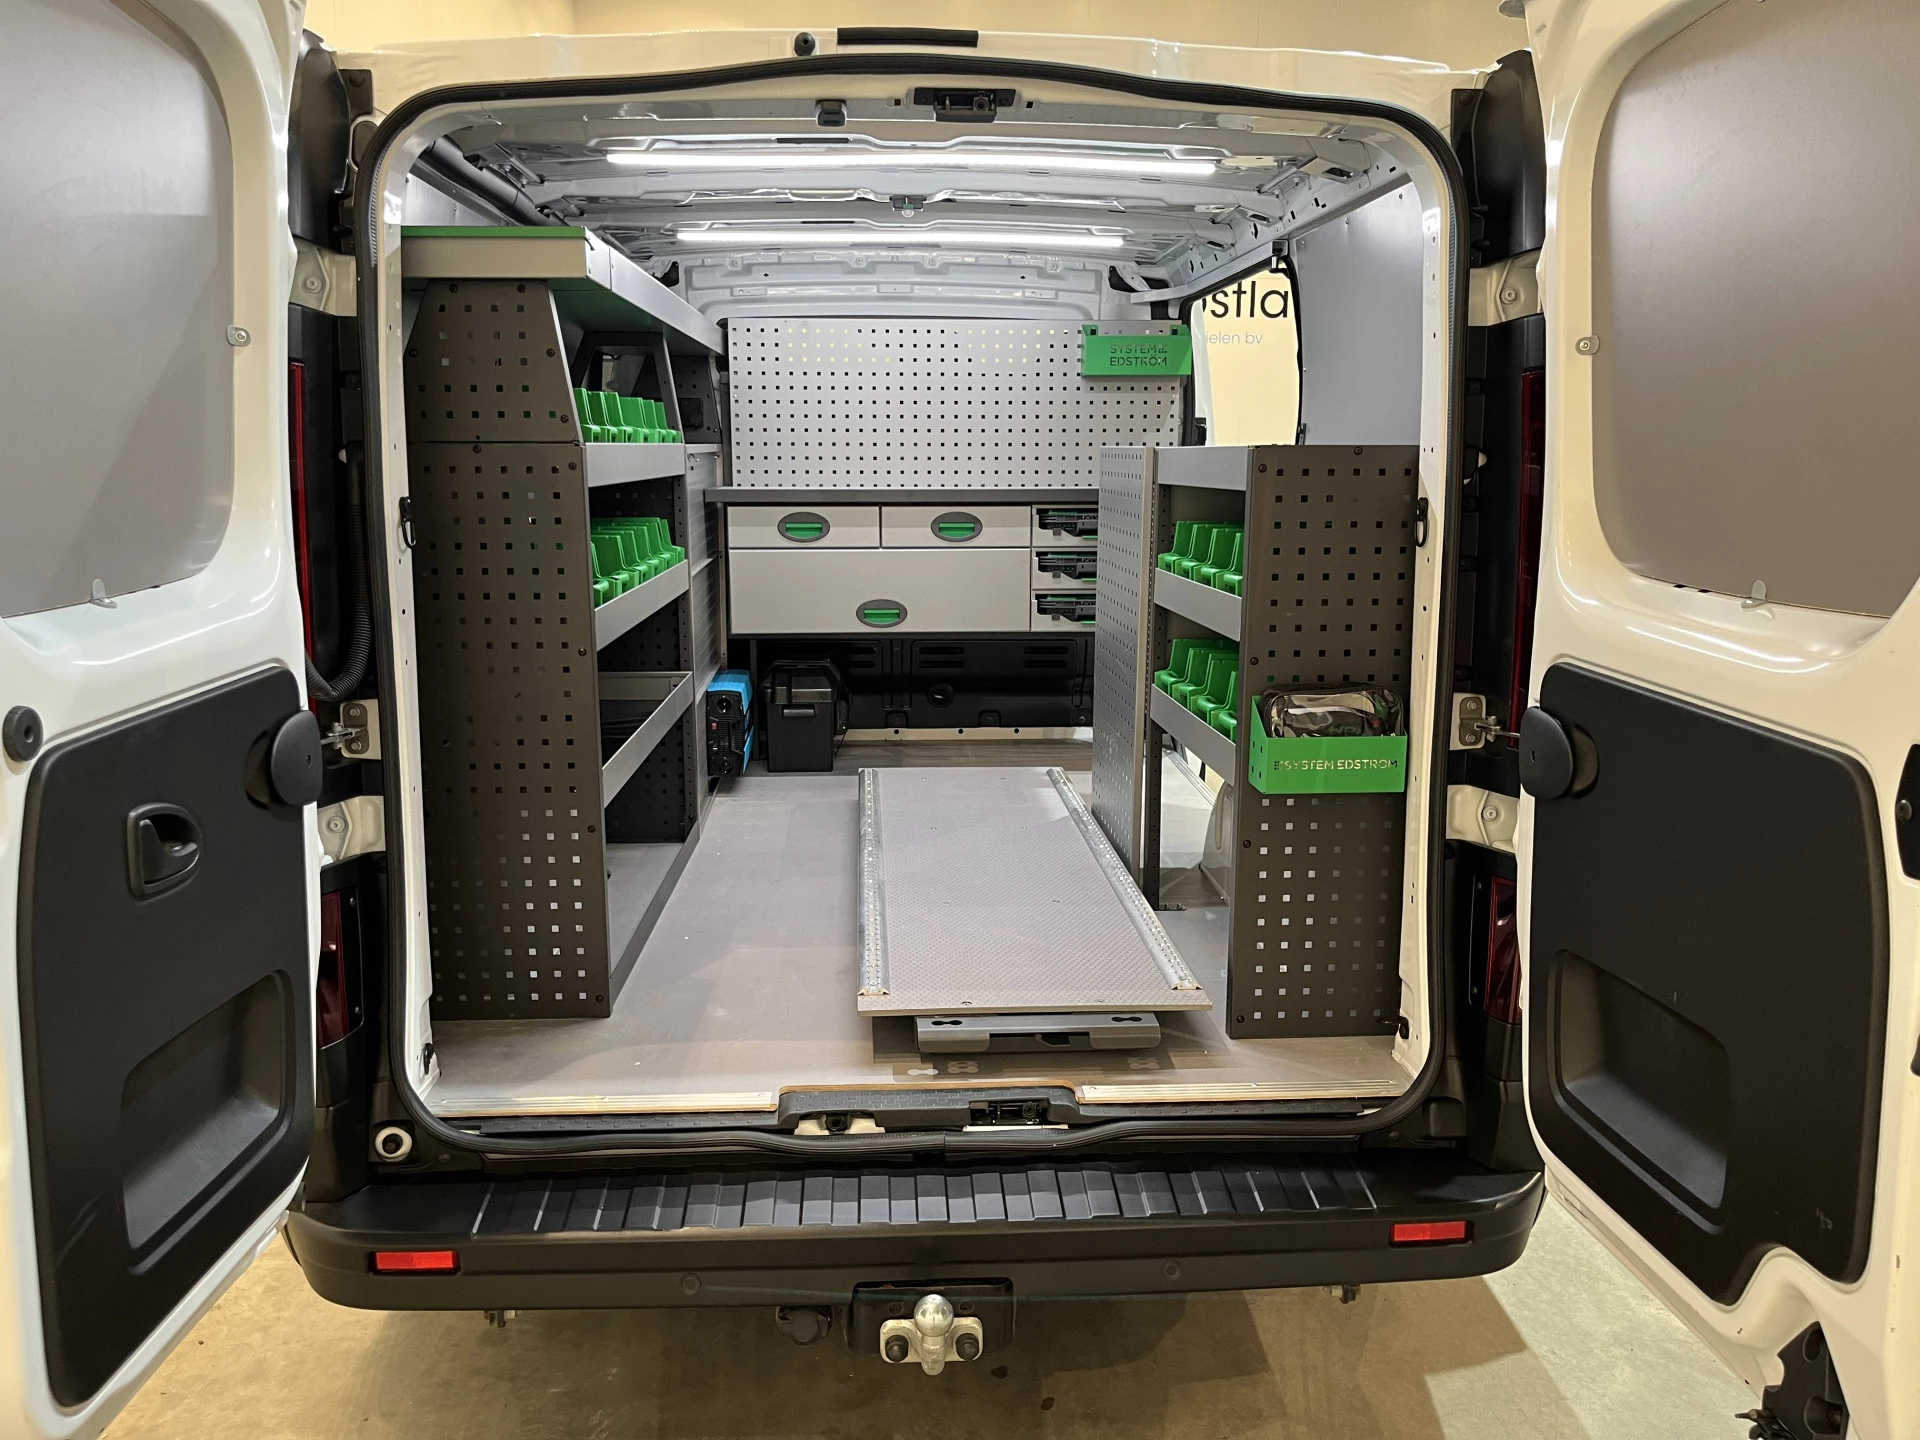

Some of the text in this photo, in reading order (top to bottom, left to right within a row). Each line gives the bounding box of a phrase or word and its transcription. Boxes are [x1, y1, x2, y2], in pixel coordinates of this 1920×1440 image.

[1202, 281, 1289, 318] stla
[1245, 332, 1263, 344] bv
[1110, 344, 1157, 354] SYSTEM
[1109, 354, 1168, 366] EDSTRÖM
[1284, 760, 1334, 770] SYSTEM
